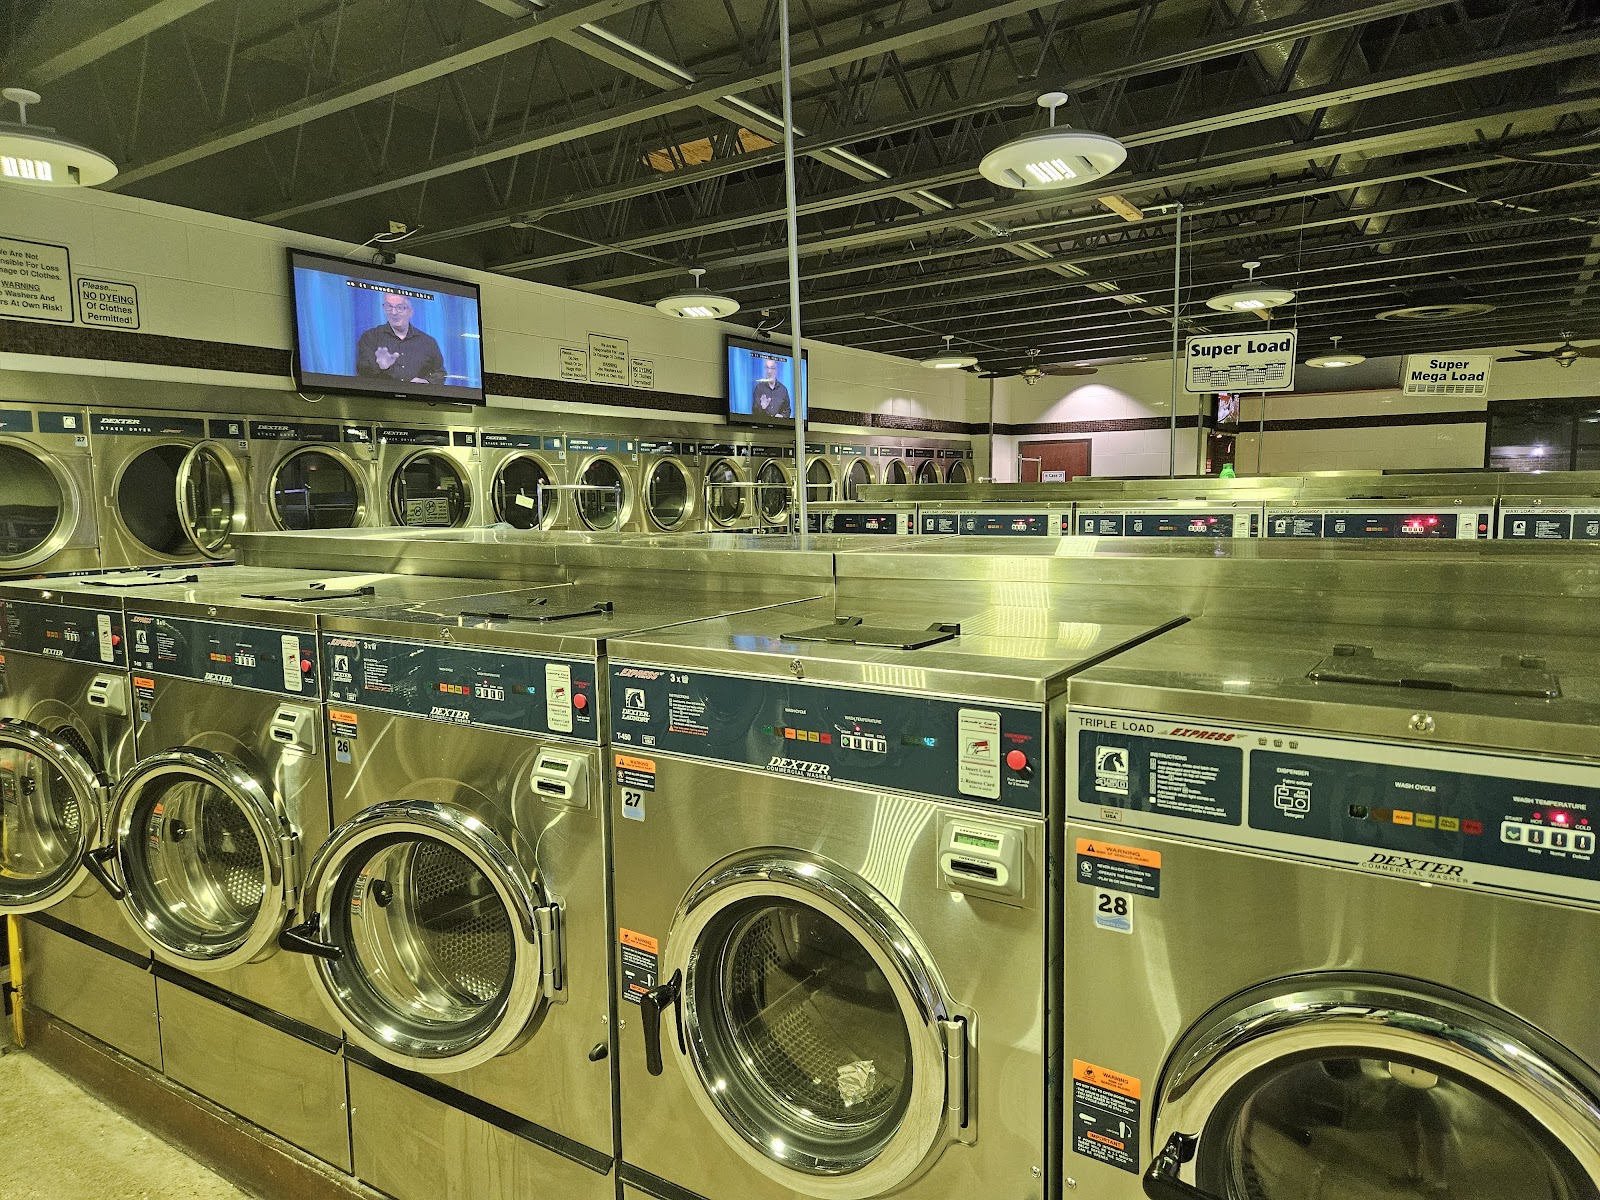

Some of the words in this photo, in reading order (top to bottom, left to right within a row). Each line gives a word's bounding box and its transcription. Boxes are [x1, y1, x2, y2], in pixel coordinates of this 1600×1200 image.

[9, 250, 23, 258] Are
[25, 251, 39, 260] Not
[25, 261, 39, 269] For
[41, 263, 60, 272] Loss
[31, 271, 62, 280] Clothes.
[1, 281, 41, 291] WARNING
[4, 289, 39, 300] Washers
[40, 294, 55, 302] And
[83, 291, 98, 300] NO
[99, 293, 135, 305] DYEING
[10, 300, 20, 308] At
[22, 301, 41, 309] Own
[42, 302, 63, 312] Risk!
[99, 304, 133, 314] Clothes
[87, 313, 133, 324] Permitted!
[1191, 343, 1242, 359] Super
[1247, 338, 1291, 354] Load
[1429, 359, 1470, 372] Super
[1411, 371, 1447, 383] Mega
[1451, 371, 1485, 381] Load
[100, 417, 141, 425] DEXTER
[204, 672, 233, 684] DEXTER
[140, 702, 149, 714] 25
[430, 706, 470, 720] DEXTER
[1078, 717, 1117, 730] TRIPLE
[1122, 721, 1154, 733] LOAD
[1169, 727, 1236, 742] EXPRESS
[337, 740, 349, 753] 26
[923, 737, 936, 747] 42
[1149, 751, 1188, 762] INSTRUCTIONS
[767, 756, 831, 775] DEXTER
[1276, 767, 1310, 777] DISPENSER
[766, 765, 805, 777] COMMERCIAL
[806, 771, 832, 781] WASHER
[1394, 782, 1414, 791] WASH
[1414, 784, 1437, 793] CYCLE
[625, 791, 641, 808] 27
[1512, 796, 1534, 805] WASH
[1535, 799, 1588, 811] TEMPERATURE
[1504, 815, 1524, 823] START
[1550, 821, 1570, 829] WARM
[1105, 846, 1141, 857] WARNING
[1369, 852, 1464, 877] DEXTER
[1361, 861, 1424, 878] COMMERCIAL
[1428, 872, 1469, 884] WASHER
[1099, 893, 1128, 916] 28
[1102, 1072, 1129, 1085] WARNING
[1090, 1132, 1122, 1149] IMPORTANT
